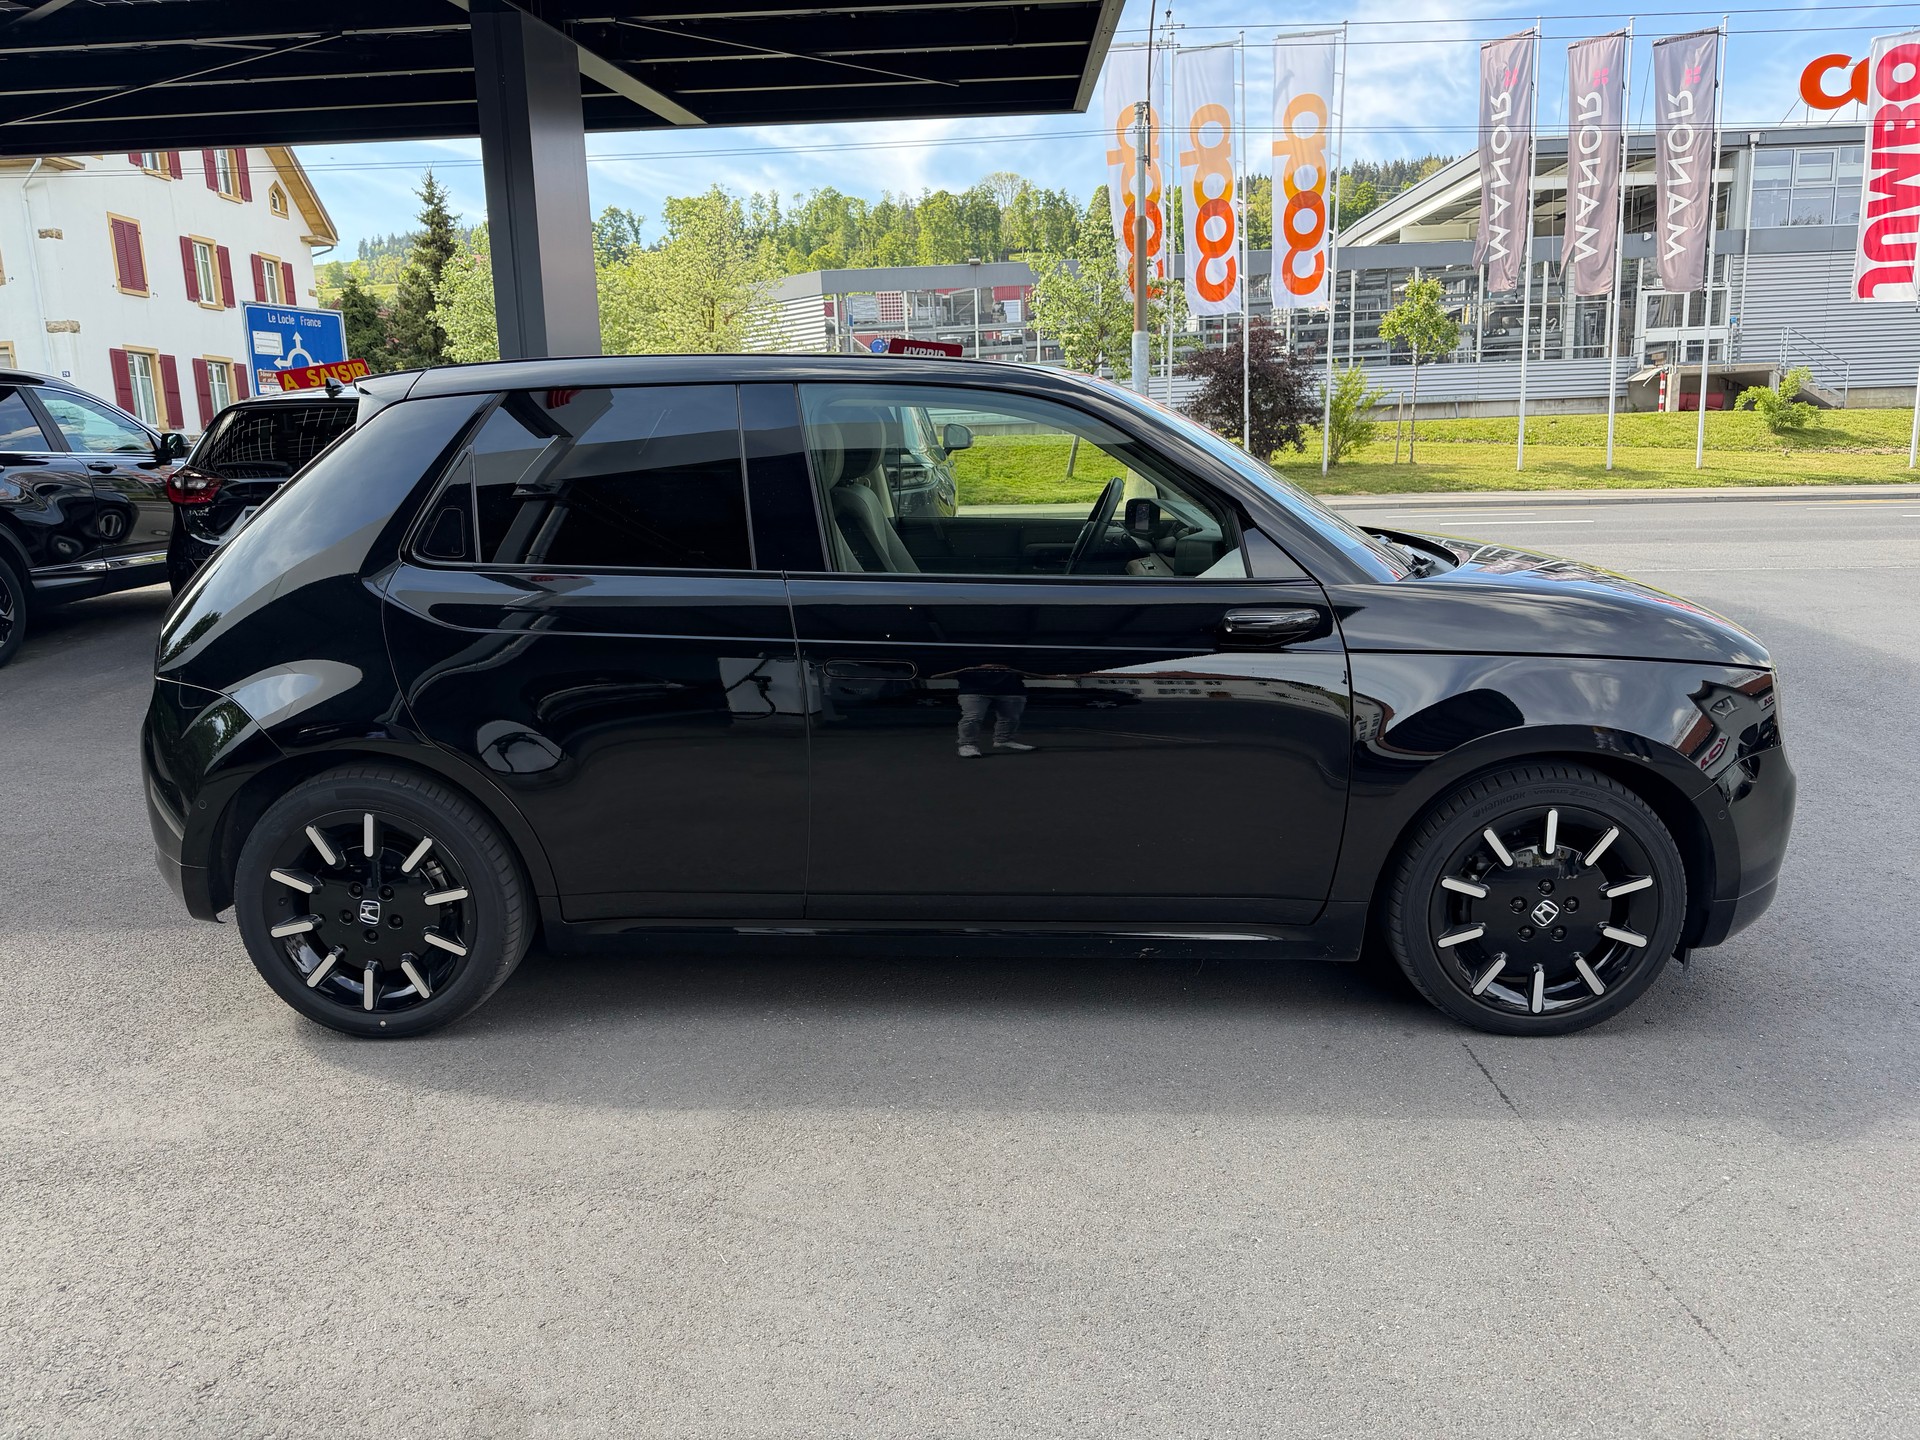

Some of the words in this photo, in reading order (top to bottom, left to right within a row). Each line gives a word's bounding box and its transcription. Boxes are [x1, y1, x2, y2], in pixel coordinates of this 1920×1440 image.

[268, 312, 276, 323] Le
[278, 313, 295, 325] Locle
[300, 316, 322, 328] France
[903, 346, 946, 357] HYBRID
[283, 373, 299, 390] A
